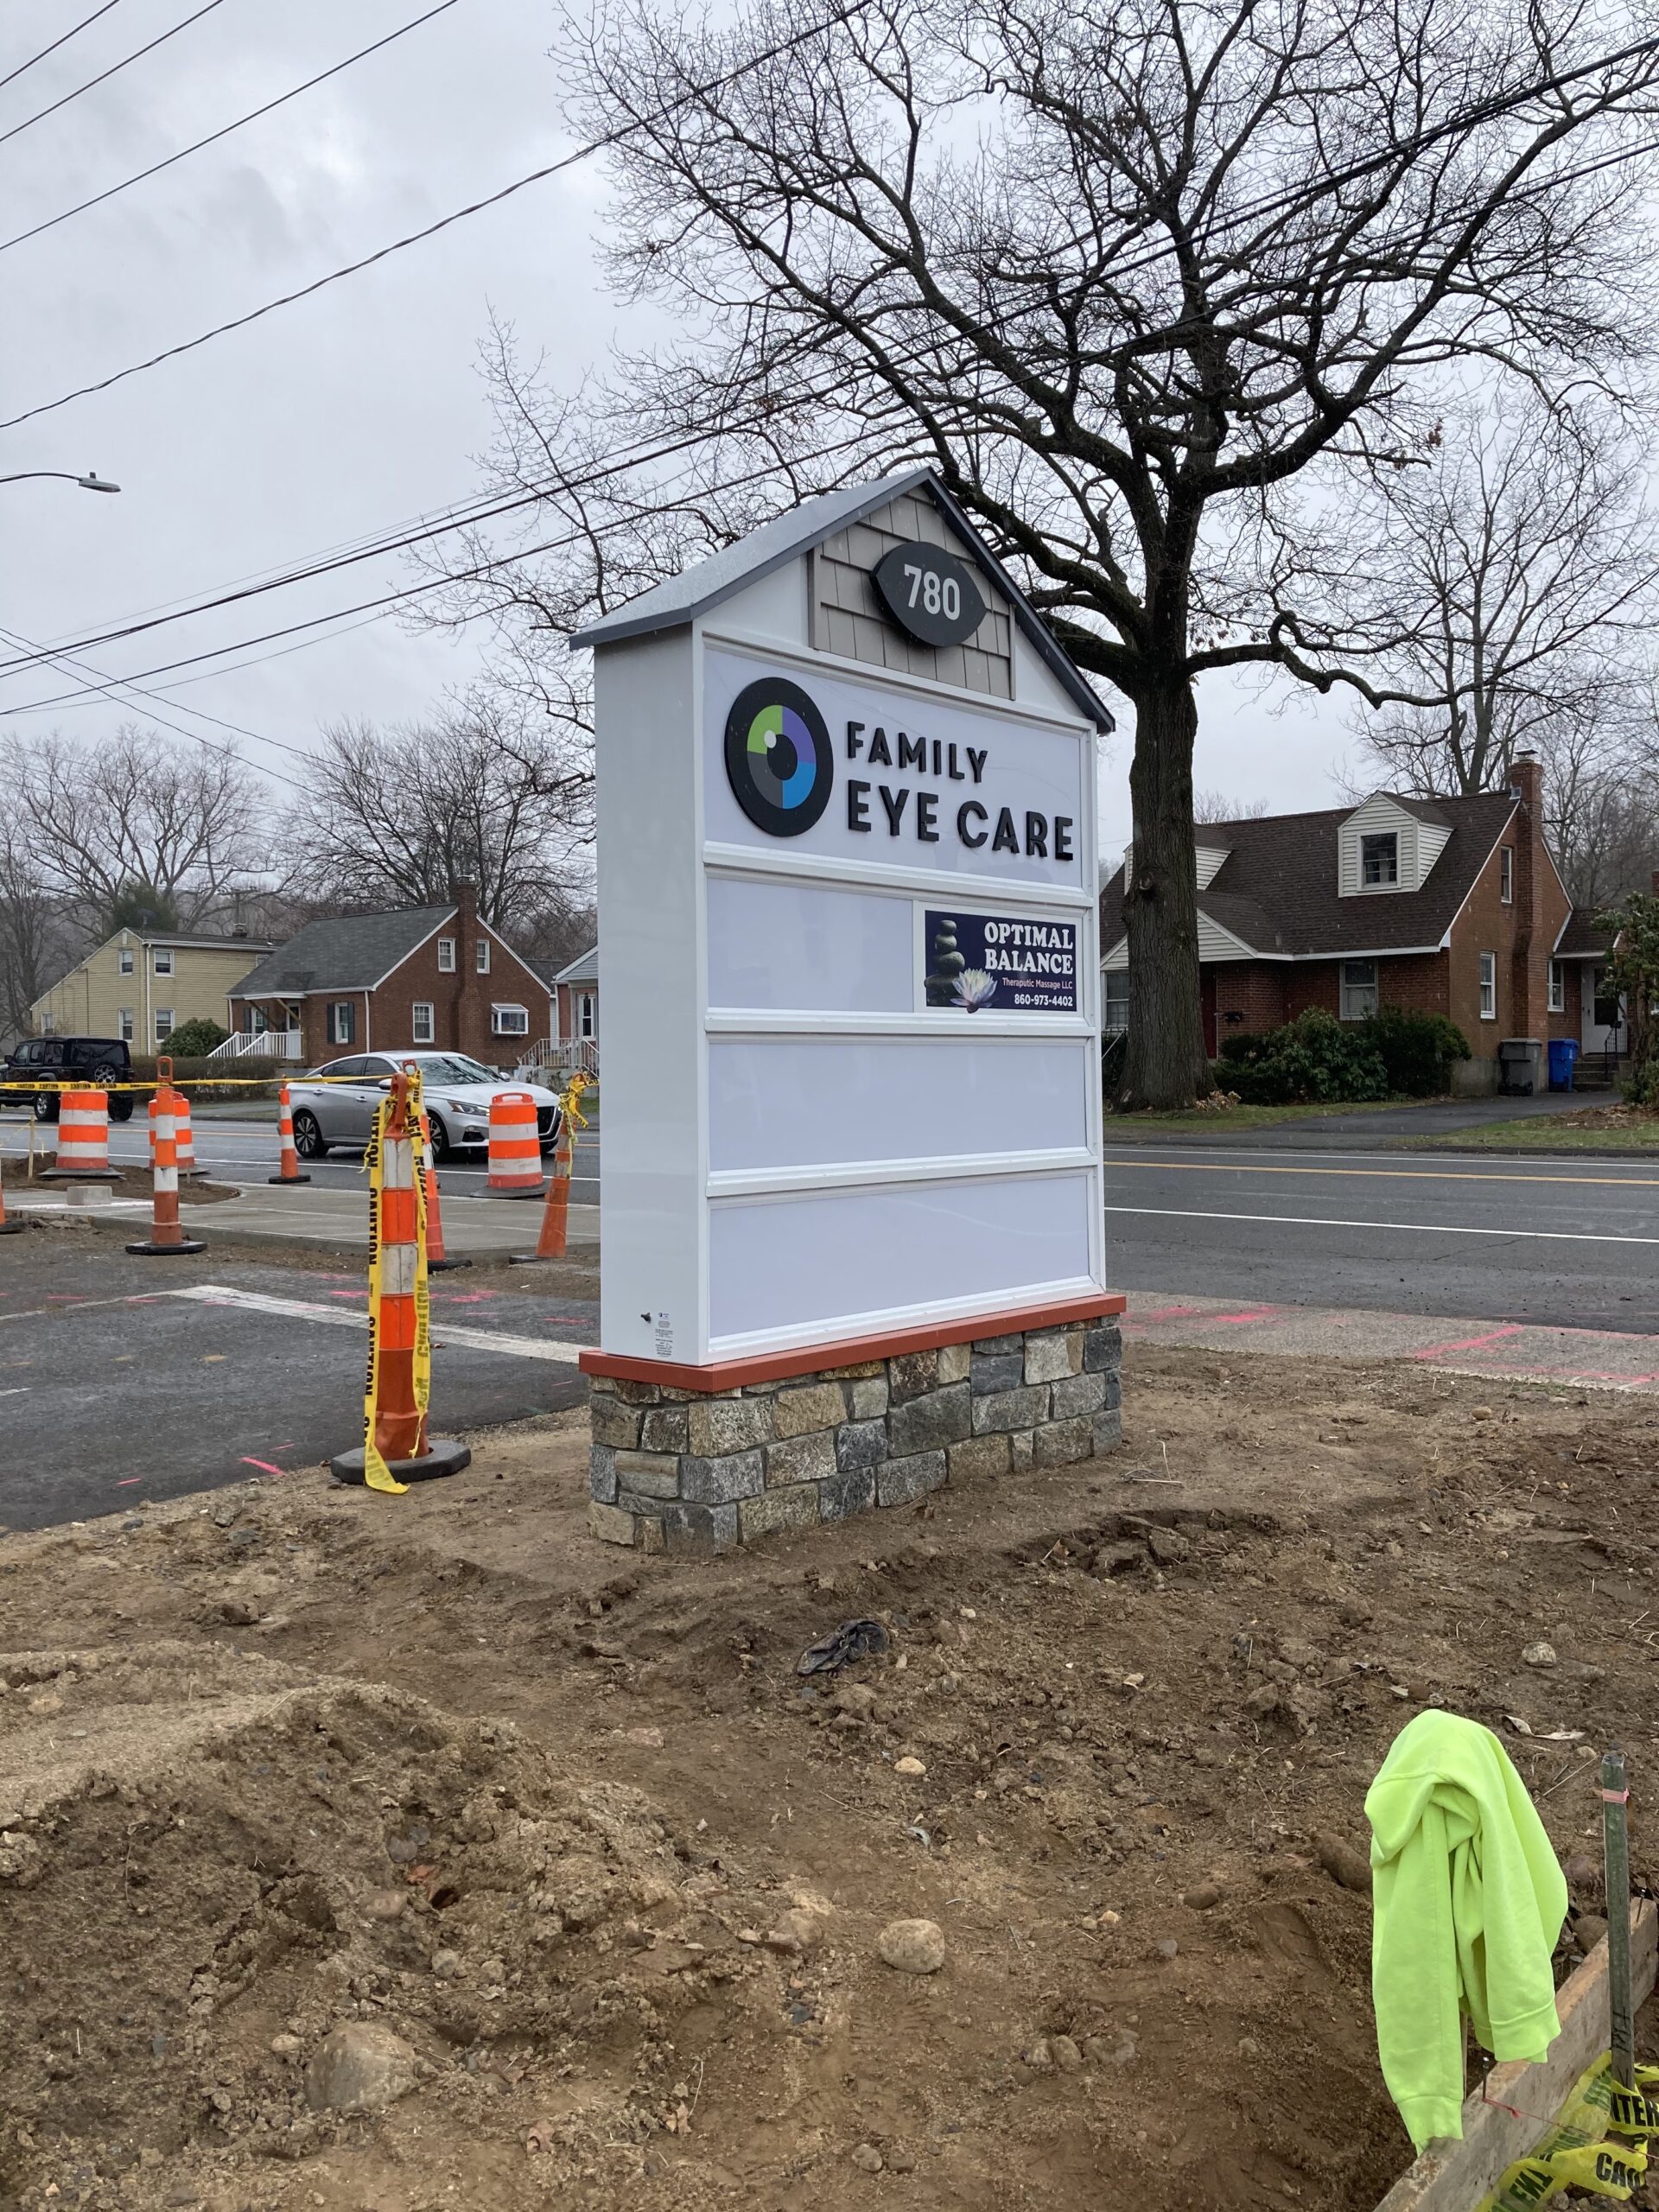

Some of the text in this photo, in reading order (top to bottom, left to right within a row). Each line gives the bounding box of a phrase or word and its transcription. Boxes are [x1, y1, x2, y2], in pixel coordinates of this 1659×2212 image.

[903, 563, 961, 620] 780
[847, 720, 988, 783] FAMILY
[847, 779, 1074, 861] EYE CARE
[984, 921, 1073, 950] OPTIMAL
[984, 948, 1073, 975] BALANCE
[1002, 977, 1073, 990] Theraputic Massage LLC
[1014, 993, 1073, 1007] 860-973-4402
